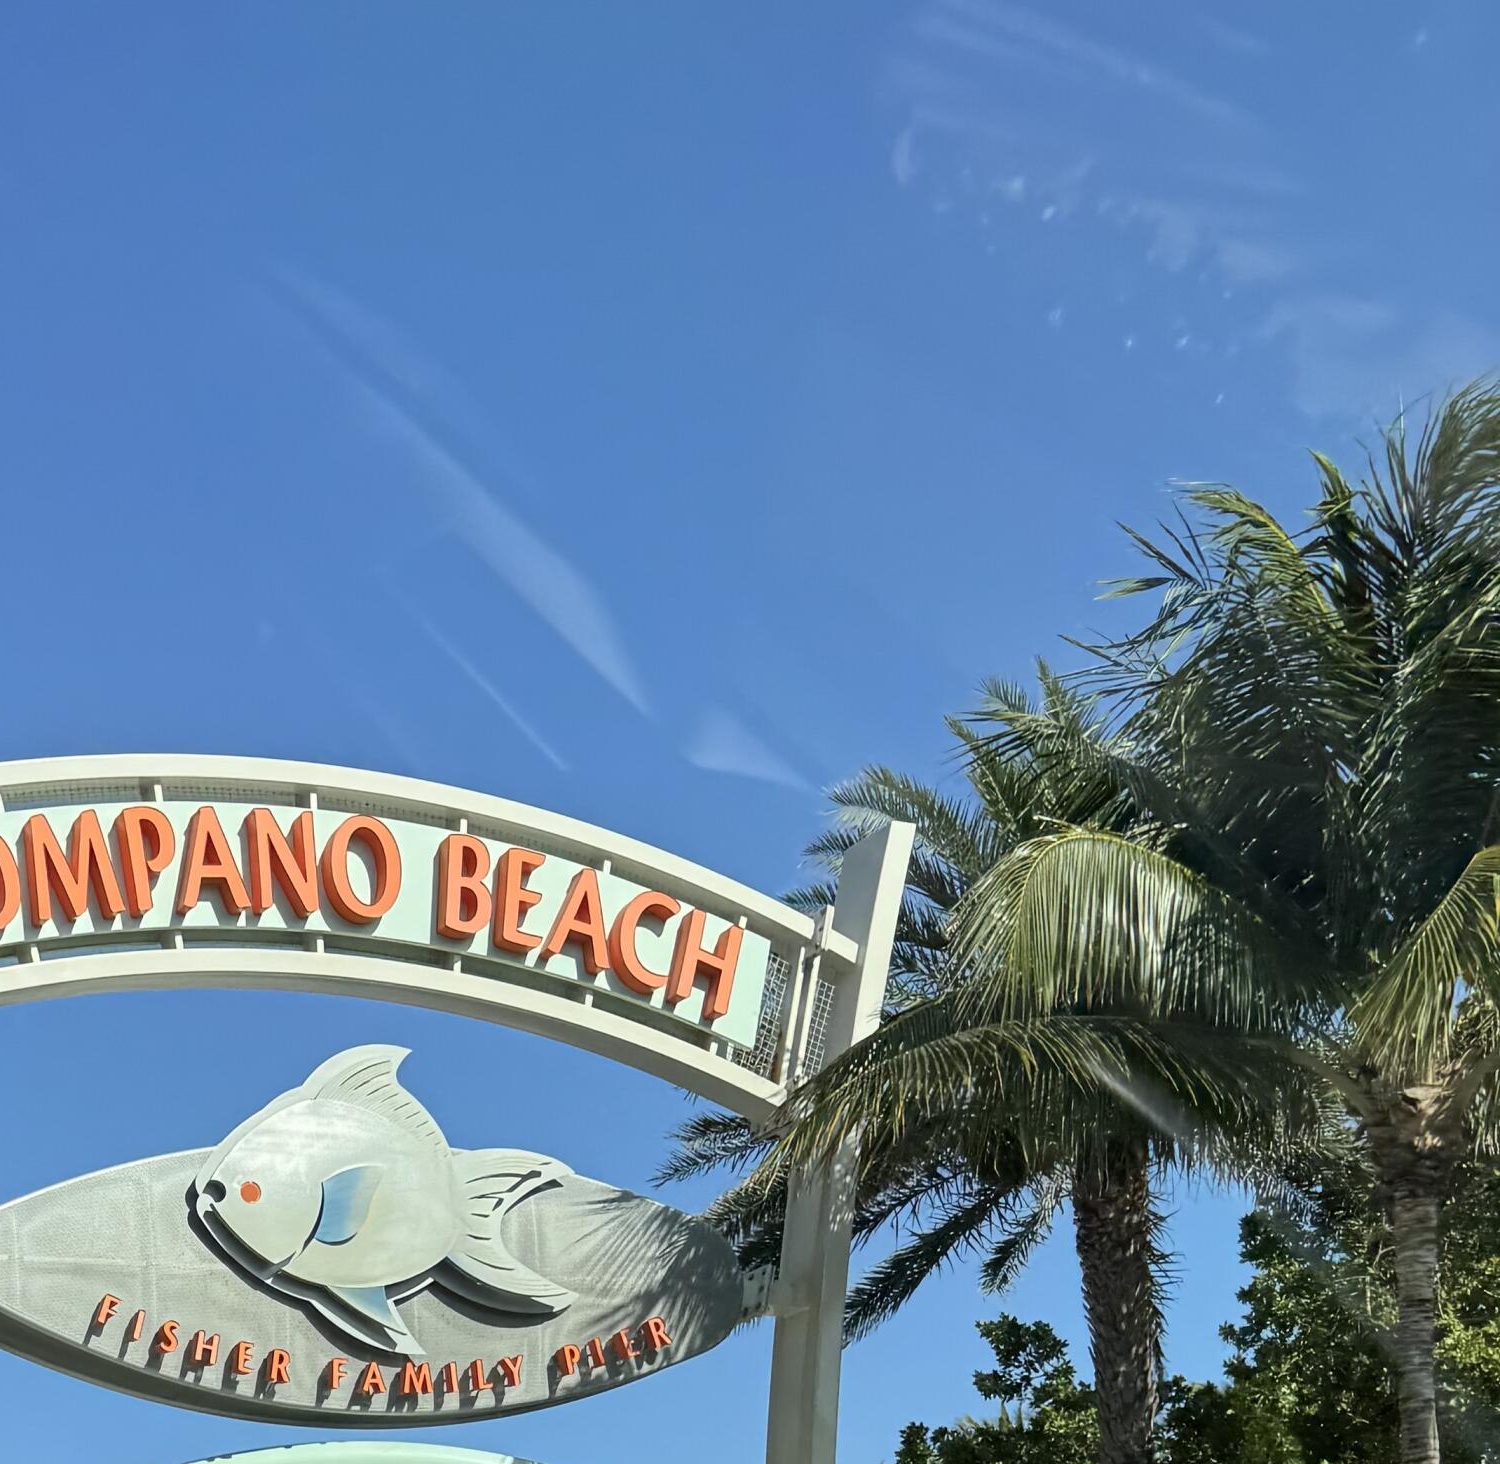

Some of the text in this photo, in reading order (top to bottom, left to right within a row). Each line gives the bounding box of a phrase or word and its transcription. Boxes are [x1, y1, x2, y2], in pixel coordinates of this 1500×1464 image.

[435, 833, 743, 1020] BEACH
[95, 1294, 672, 1395] FISHER FAMILY PIER
